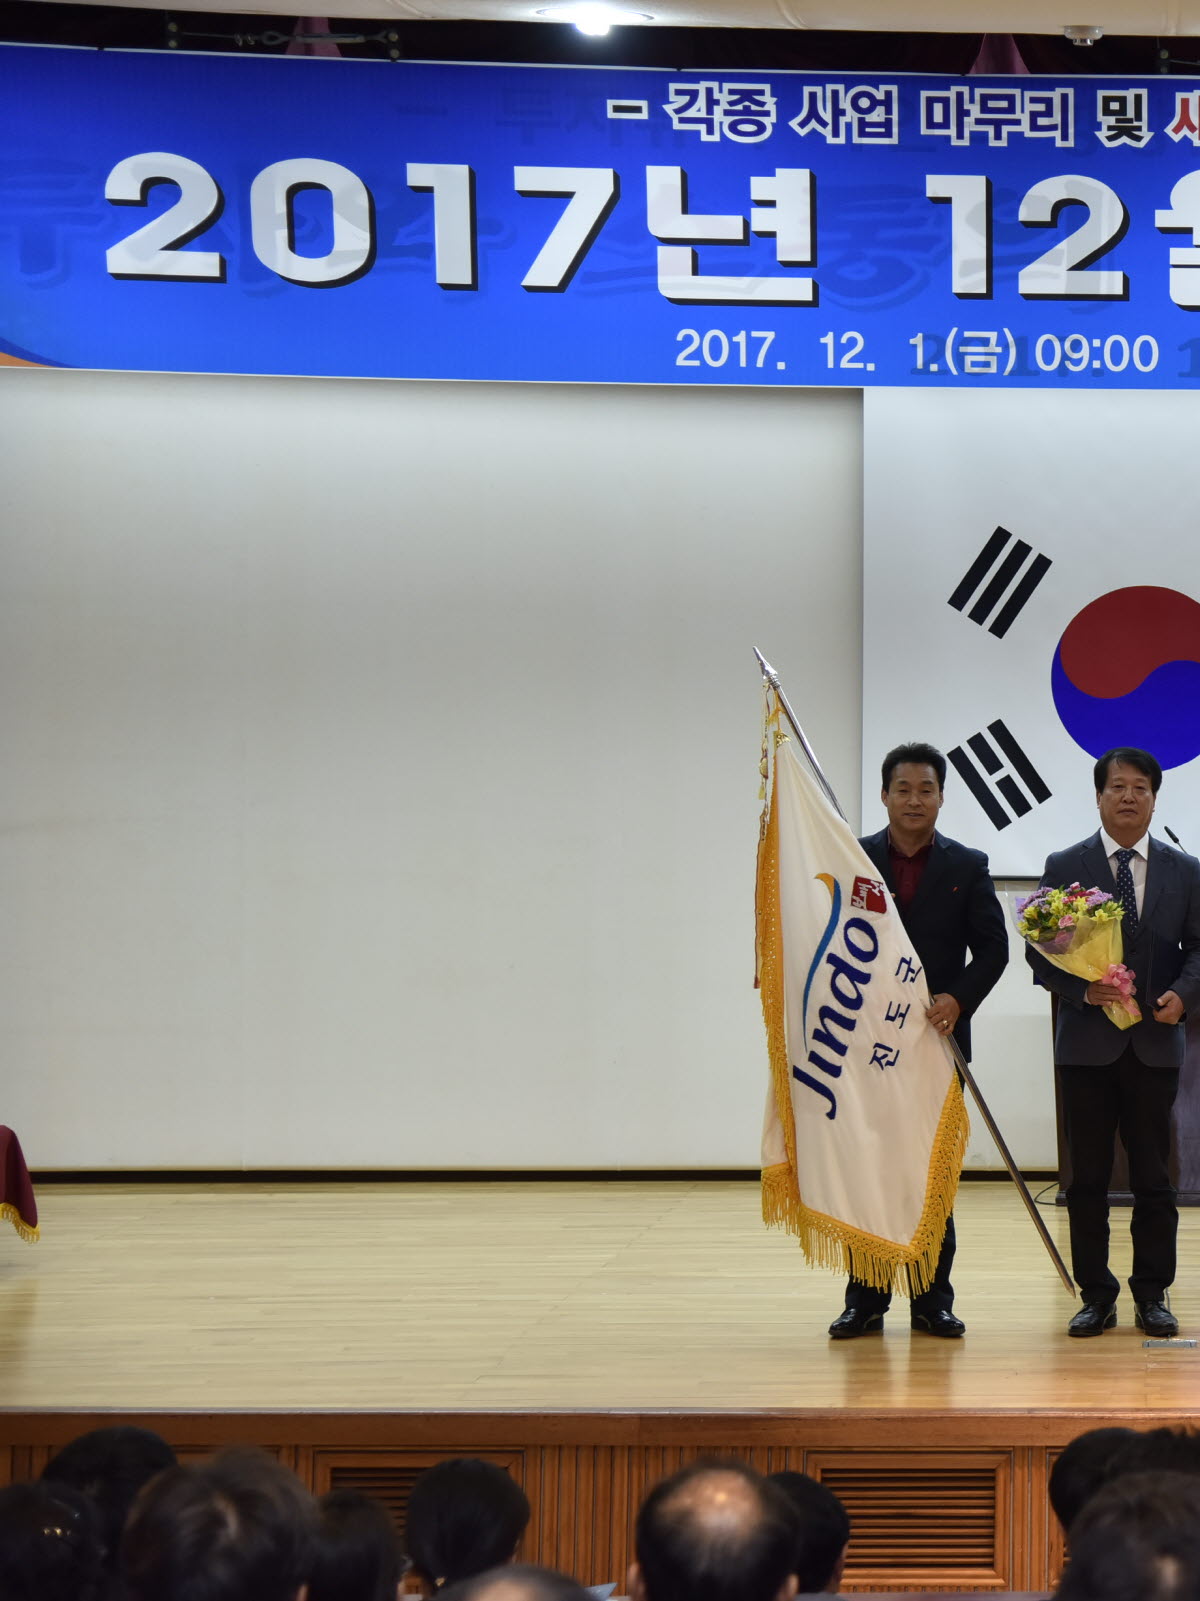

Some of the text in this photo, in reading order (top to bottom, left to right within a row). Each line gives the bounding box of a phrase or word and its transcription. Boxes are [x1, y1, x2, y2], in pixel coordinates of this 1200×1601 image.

[662, 81, 778, 142] 각종
[788, 84, 899, 144] 사업
[920, 85, 1074, 147] 마무리
[1095, 88, 1154, 147] 및
[104, 151, 819, 307] 2017년
[675, 328, 786, 370] 2017.
[819, 330, 876, 371] 12.
[1035, 332, 1159, 373] 09:00
[792, 916, 879, 1120] Jindo
